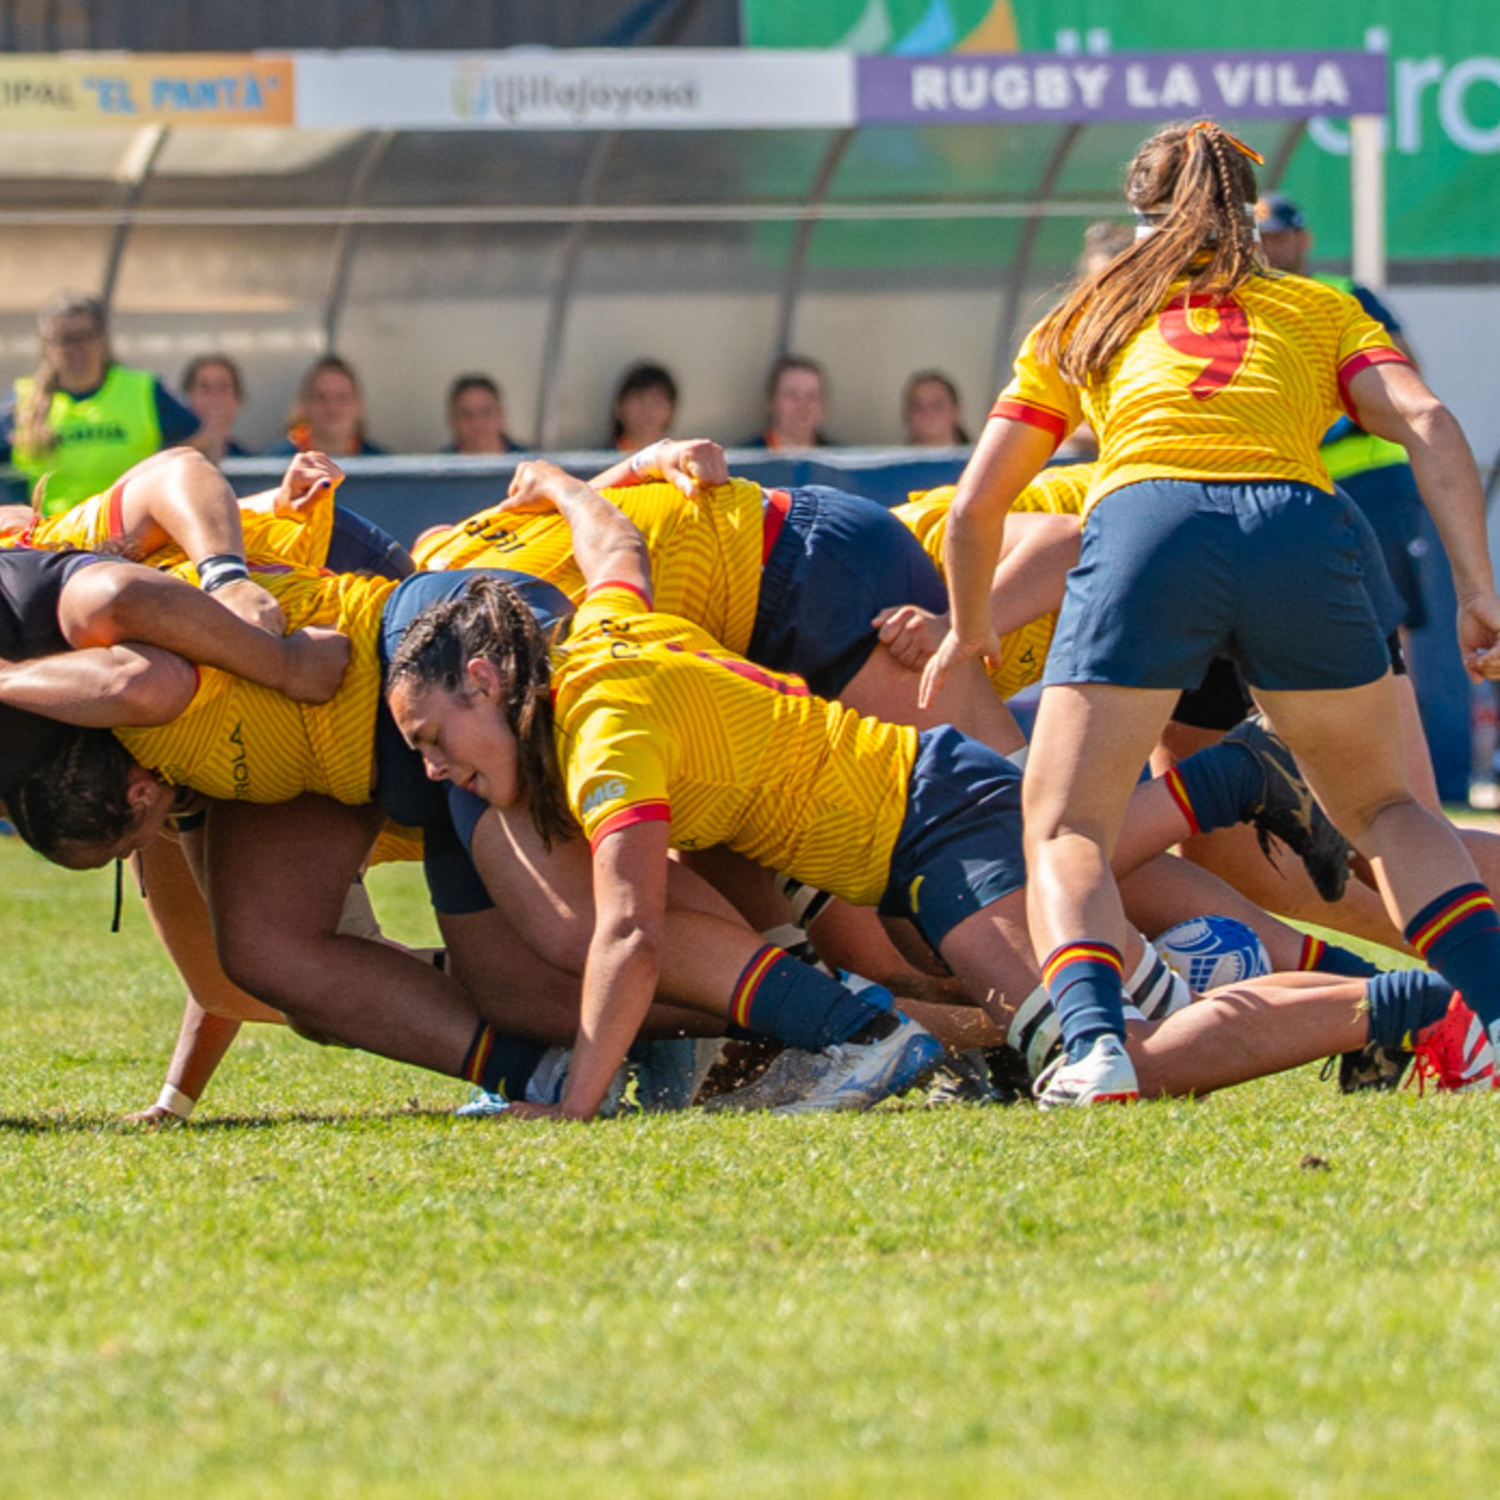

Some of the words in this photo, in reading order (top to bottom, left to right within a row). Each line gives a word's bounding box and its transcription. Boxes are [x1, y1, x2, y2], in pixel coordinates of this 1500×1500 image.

[910, 63, 1111, 111] RUGBY
[1125, 63, 1201, 109] LA
[1212, 61, 1352, 108] VILA
[1157, 288, 1258, 403] 9
